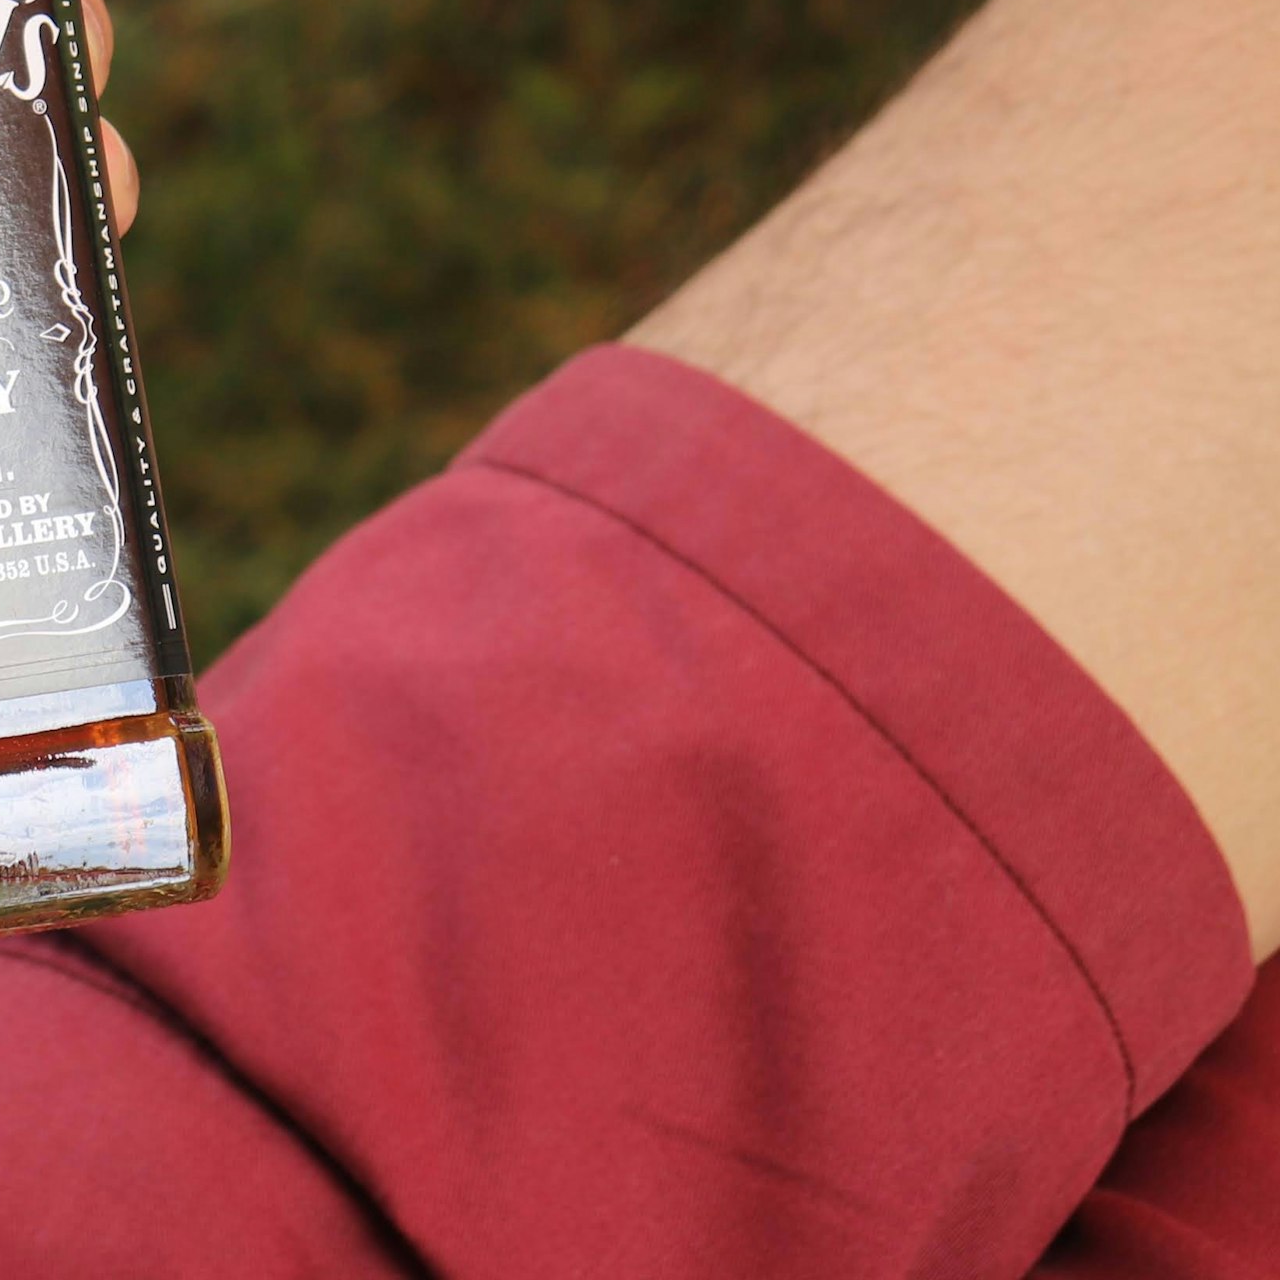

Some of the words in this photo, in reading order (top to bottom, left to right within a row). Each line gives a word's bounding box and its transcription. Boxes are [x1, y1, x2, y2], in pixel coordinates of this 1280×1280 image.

[65, 20, 88, 113] SINCE
[84, 126, 136, 396] CRAFTSMANSHIP
[132, 406, 142, 425] &
[19, 493, 51, 516] BY
[136, 436, 167, 574] QUALITY
[34, 549, 96, 575] U.S.A.
